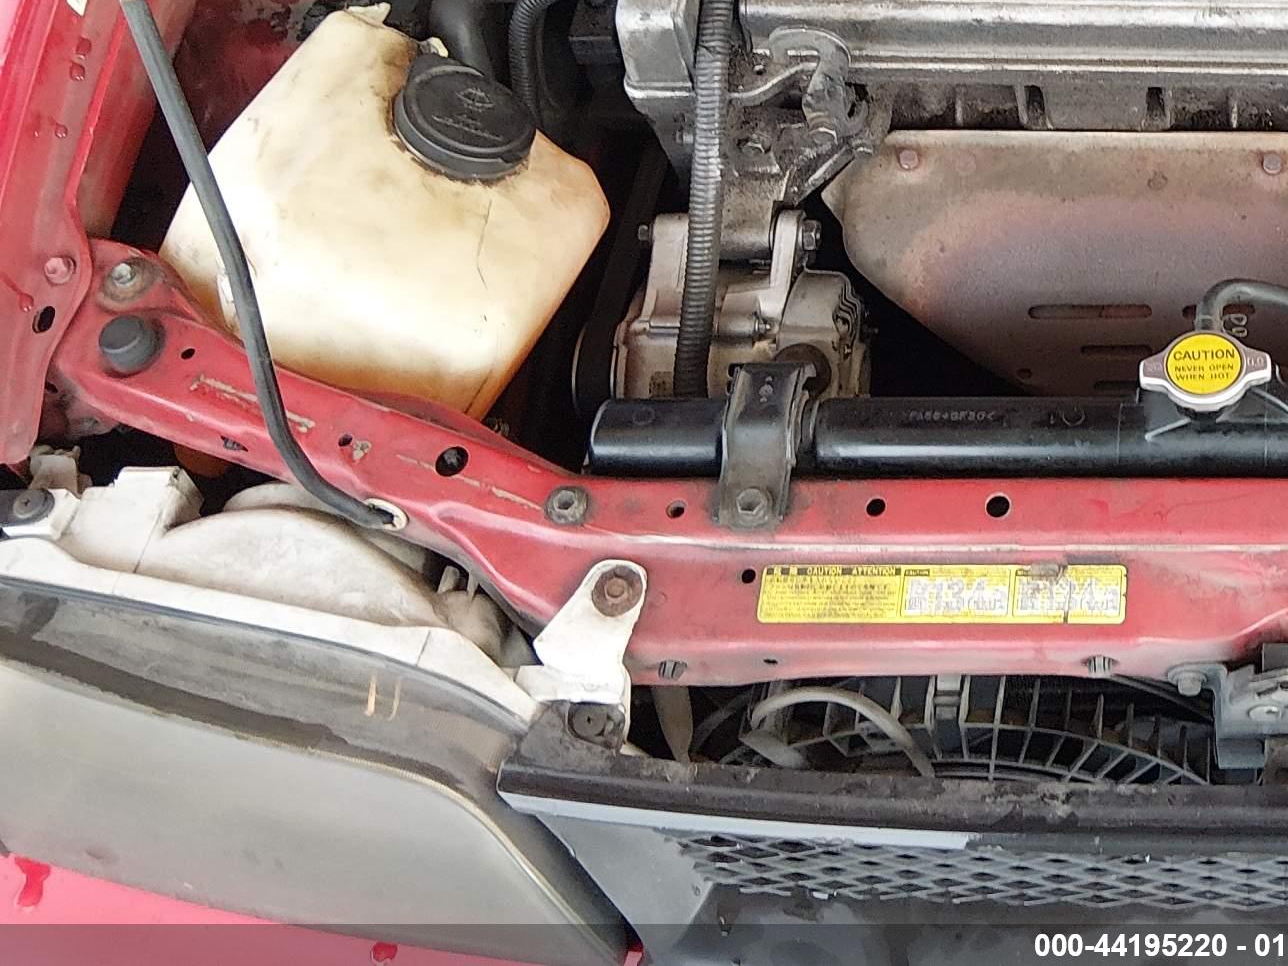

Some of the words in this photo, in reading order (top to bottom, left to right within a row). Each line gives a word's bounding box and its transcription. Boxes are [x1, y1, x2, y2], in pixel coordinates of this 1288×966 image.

[1173, 348, 1236, 362] CAUTION
[1175, 364, 1205, 373] NEVER
[1209, 363, 1234, 372] OPEN
[1176, 373, 1205, 382] WHEN
[807, 567, 842, 576] CAUTION
[852, 567, 897, 576] ATTENTION
